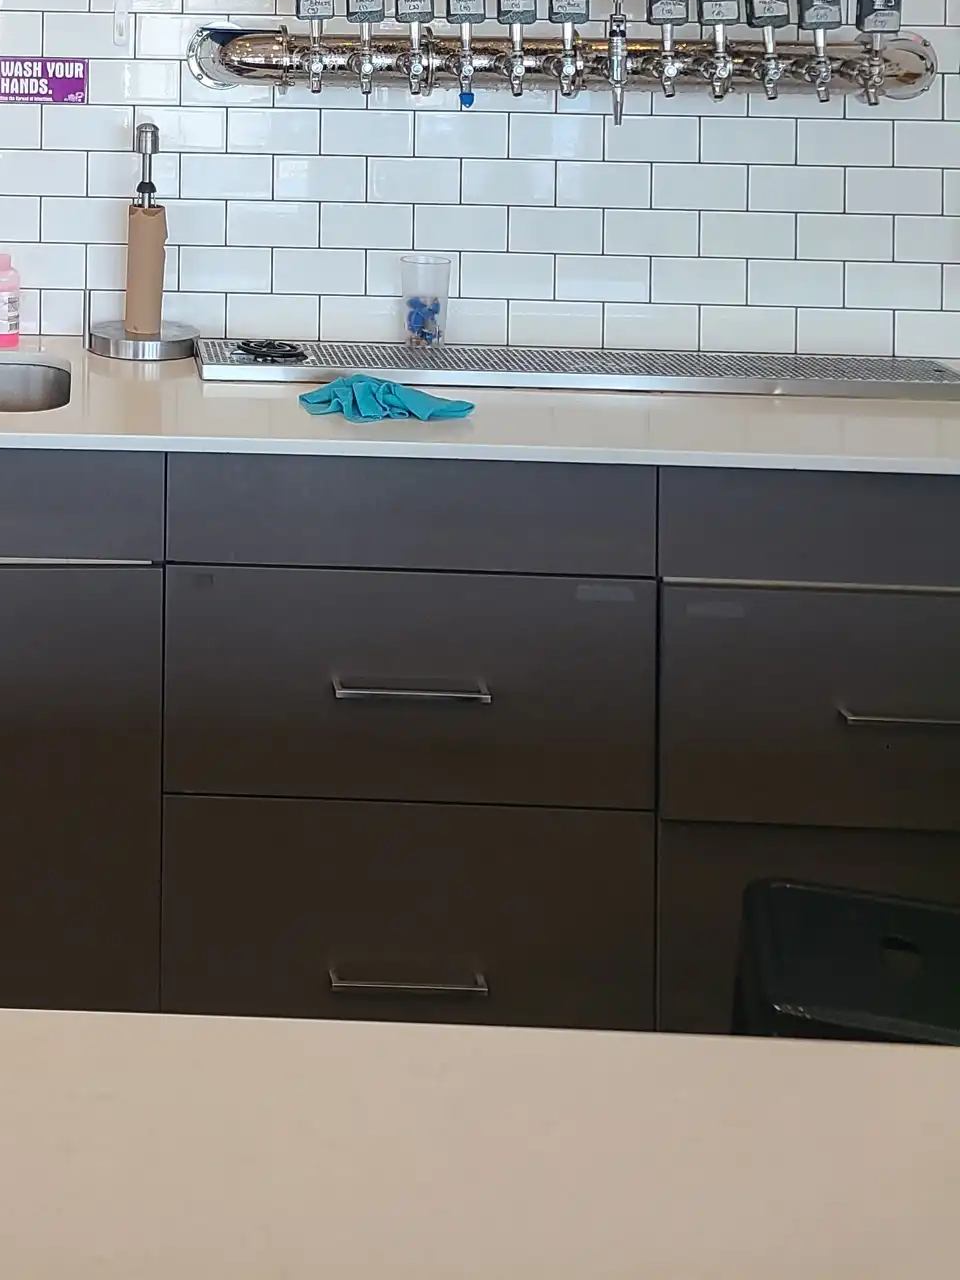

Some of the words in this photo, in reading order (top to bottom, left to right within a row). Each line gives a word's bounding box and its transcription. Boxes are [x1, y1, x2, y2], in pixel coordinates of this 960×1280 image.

[0, 60, 42, 78] WASH
[46, 61, 84, 79] YOUR
[0, 78, 53, 95] HANDS.
